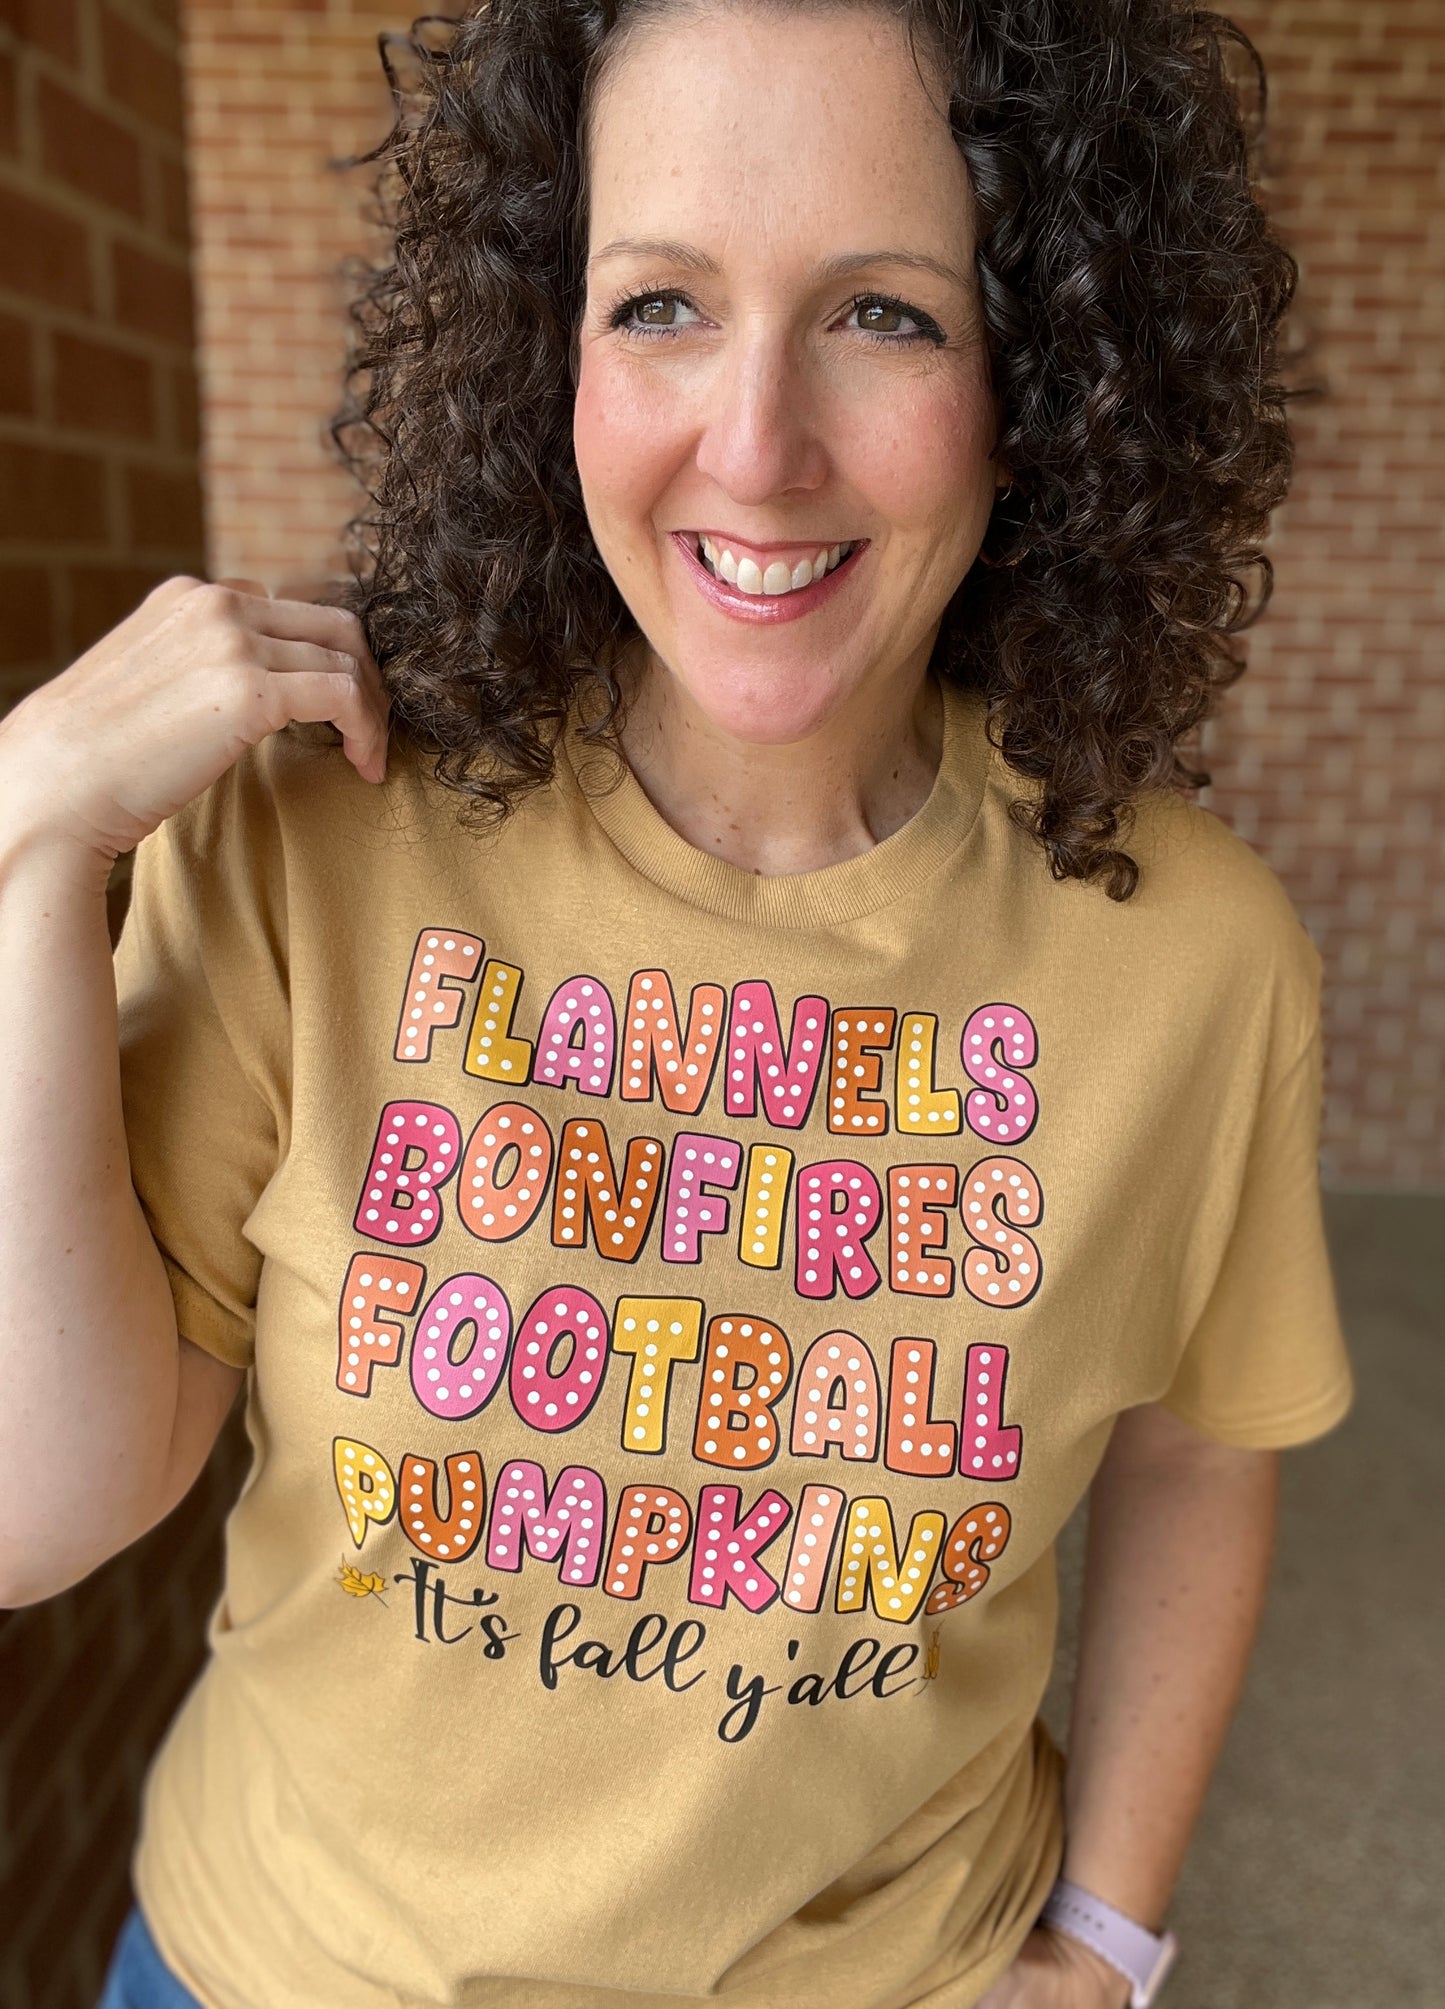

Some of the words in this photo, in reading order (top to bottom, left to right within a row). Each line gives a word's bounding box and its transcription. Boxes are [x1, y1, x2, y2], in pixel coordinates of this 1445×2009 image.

[394, 927, 1040, 1145] FLANNELS
[353, 1100, 1044, 1310] BONFIRES
[336, 1251, 1024, 1481] FOOTBALL
[332, 1436, 1012, 1624] PUMPKINS
[394, 1556, 522, 1660] It's
[539, 1603, 707, 1691] fall
[716, 1636, 921, 1743] y'all
